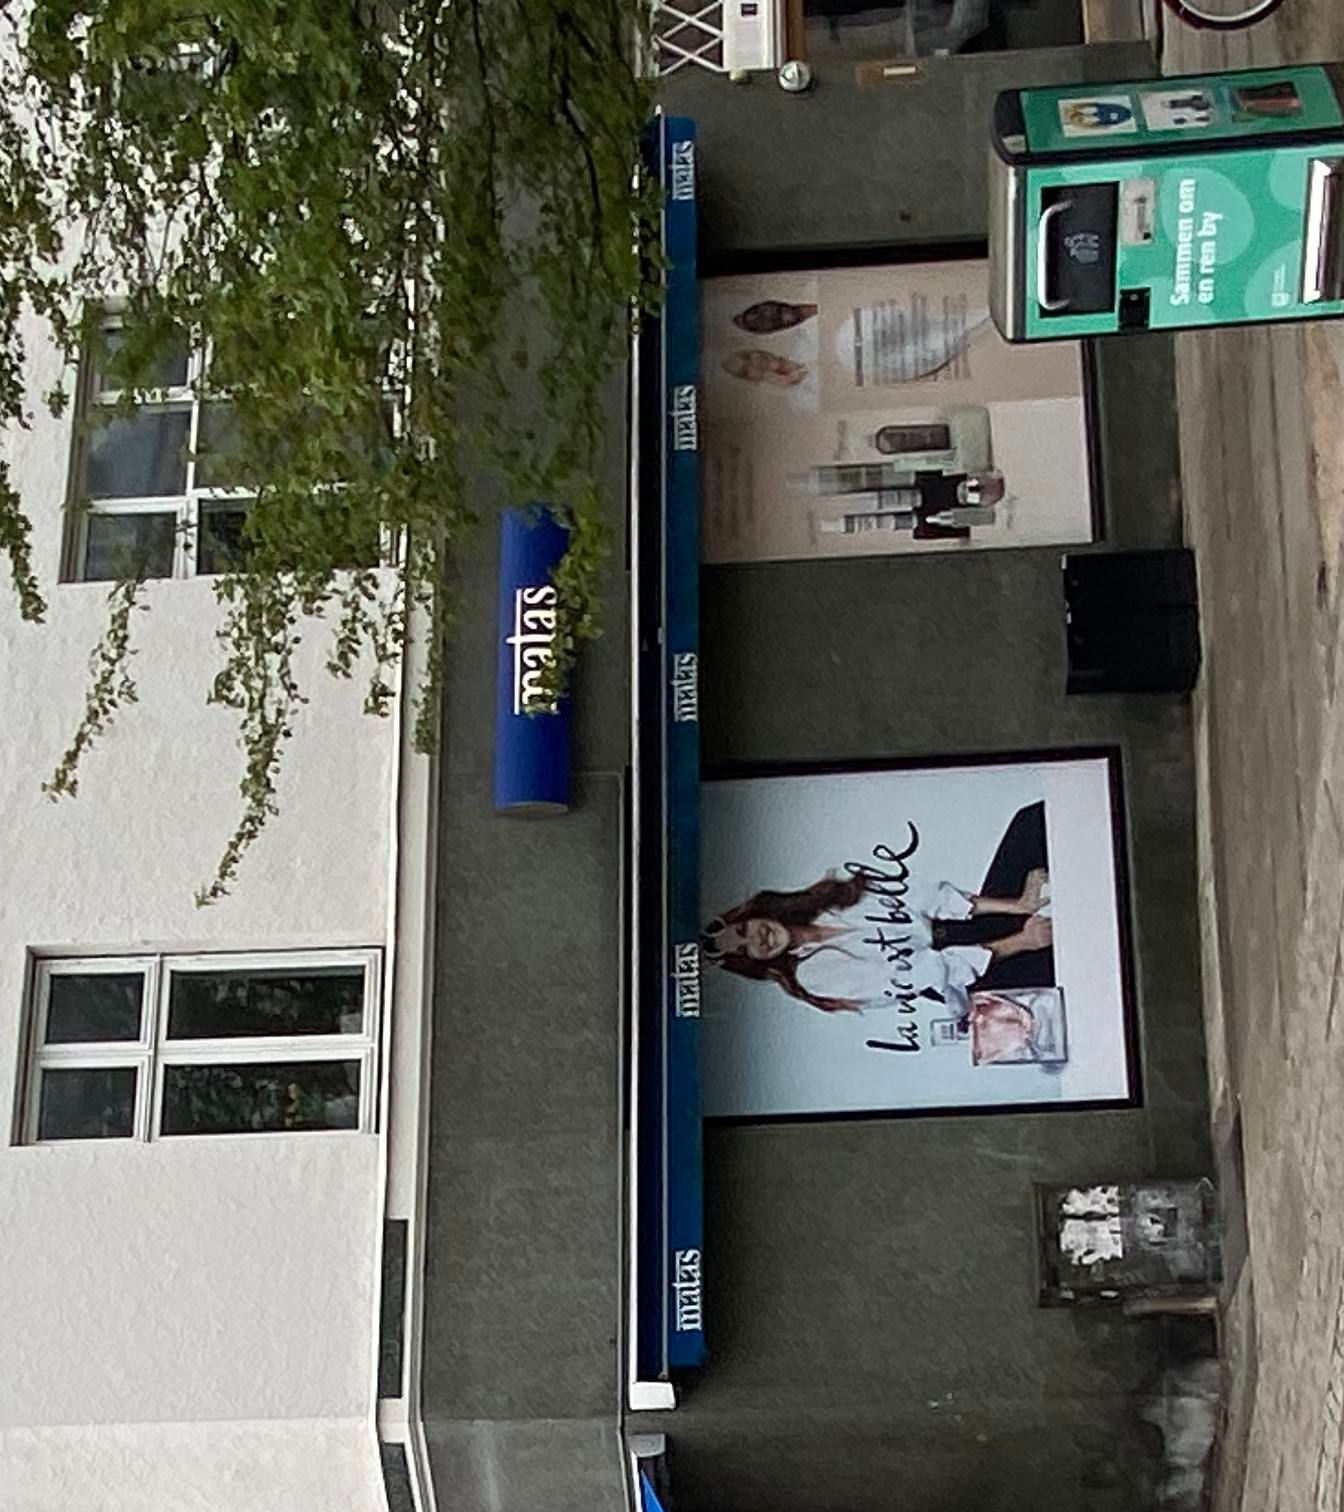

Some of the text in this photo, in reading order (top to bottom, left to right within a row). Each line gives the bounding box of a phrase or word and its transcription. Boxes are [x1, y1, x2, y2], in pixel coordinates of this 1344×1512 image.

[669, 140, 695, 200] matas
[1169, 178, 1196, 306] Sammen om
[1196, 212, 1224, 304] en ren by
[669, 385, 697, 450] matas
[671, 653, 698, 722] matas
[844, 821, 920, 1052] La vie est belle
[671, 942, 701, 1018] matas
[673, 1248, 702, 1332] matas
